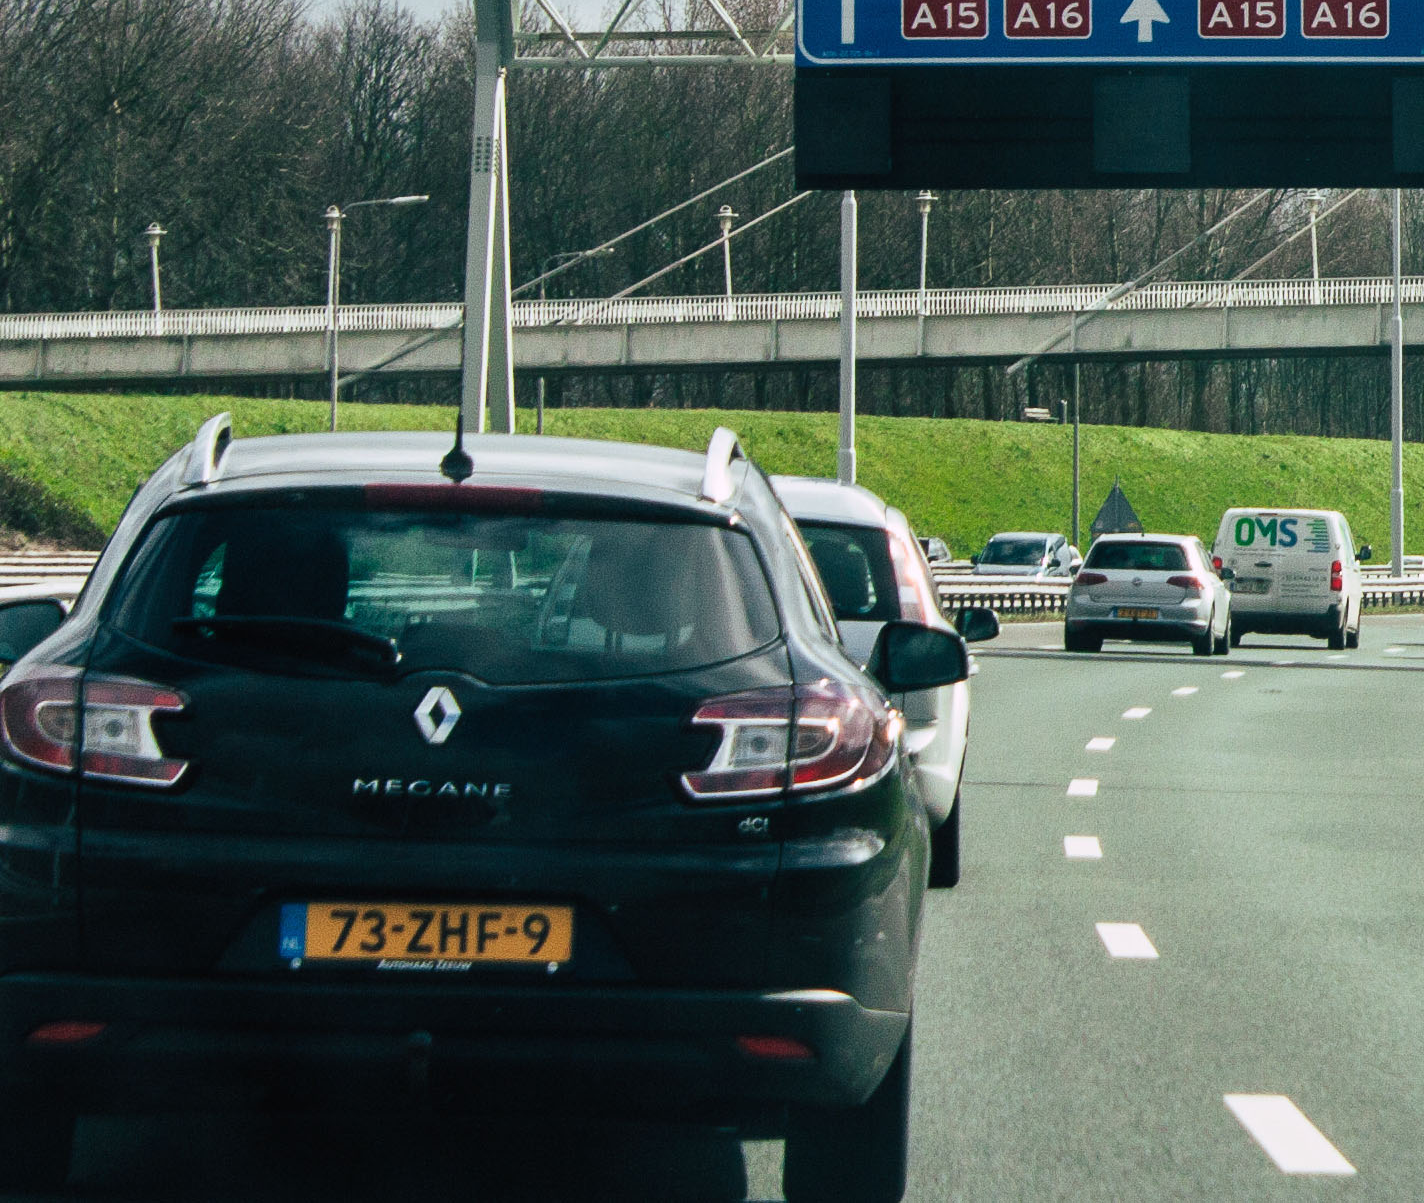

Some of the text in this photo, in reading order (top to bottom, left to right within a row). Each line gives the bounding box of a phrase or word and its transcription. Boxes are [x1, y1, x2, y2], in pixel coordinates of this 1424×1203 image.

[911, 1, 1381, 30] A15 A16 A15 A16
[1235, 517, 1298, 547] OMS
[350, 775, 514, 801] MEGANE
[330, 908, 552, 955] 73-ZHF-9
